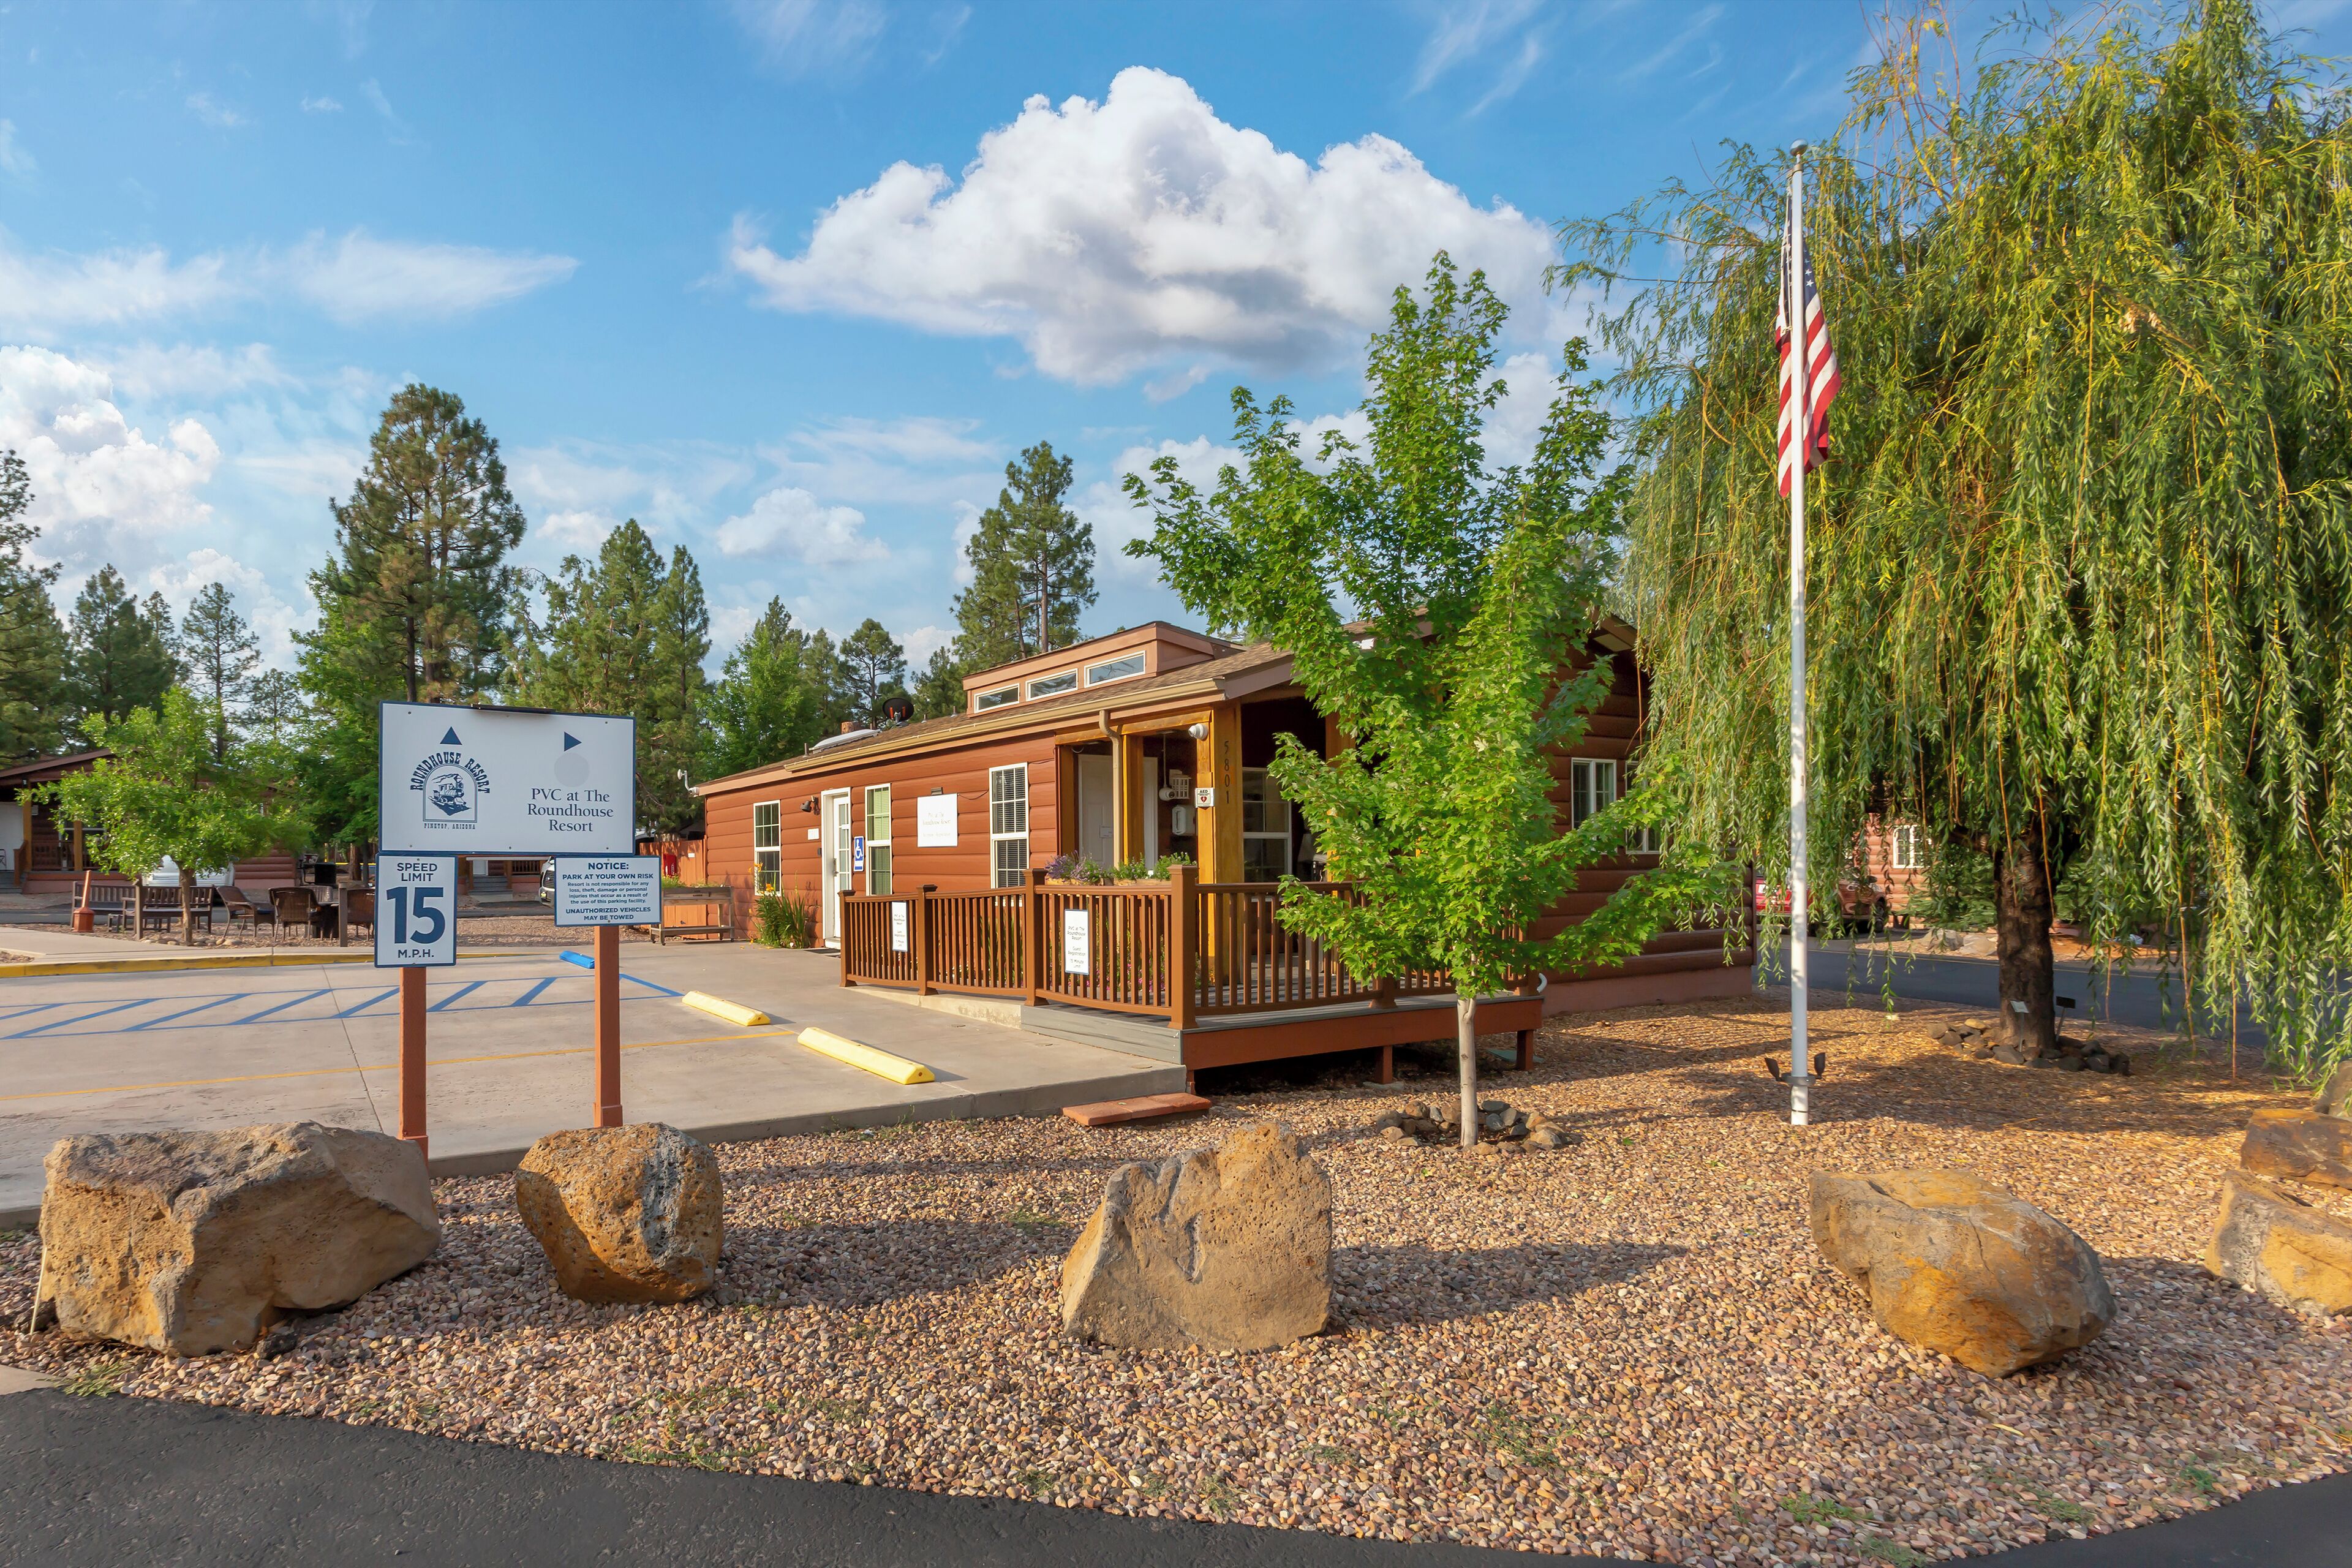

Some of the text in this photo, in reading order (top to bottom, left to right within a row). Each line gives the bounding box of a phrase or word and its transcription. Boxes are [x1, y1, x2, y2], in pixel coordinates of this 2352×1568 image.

[410, 752, 490, 793] ROUNDHOUSE RESORT
[531, 788, 610, 802] PVC at The
[527, 803, 614, 817] Roundhouse
[549, 820, 593, 832] Resort
[397, 863, 437, 872] SPEED
[401, 873, 434, 881] LIMIT
[386, 886, 446, 944] 15
[398, 949, 434, 958] M.P.H.
